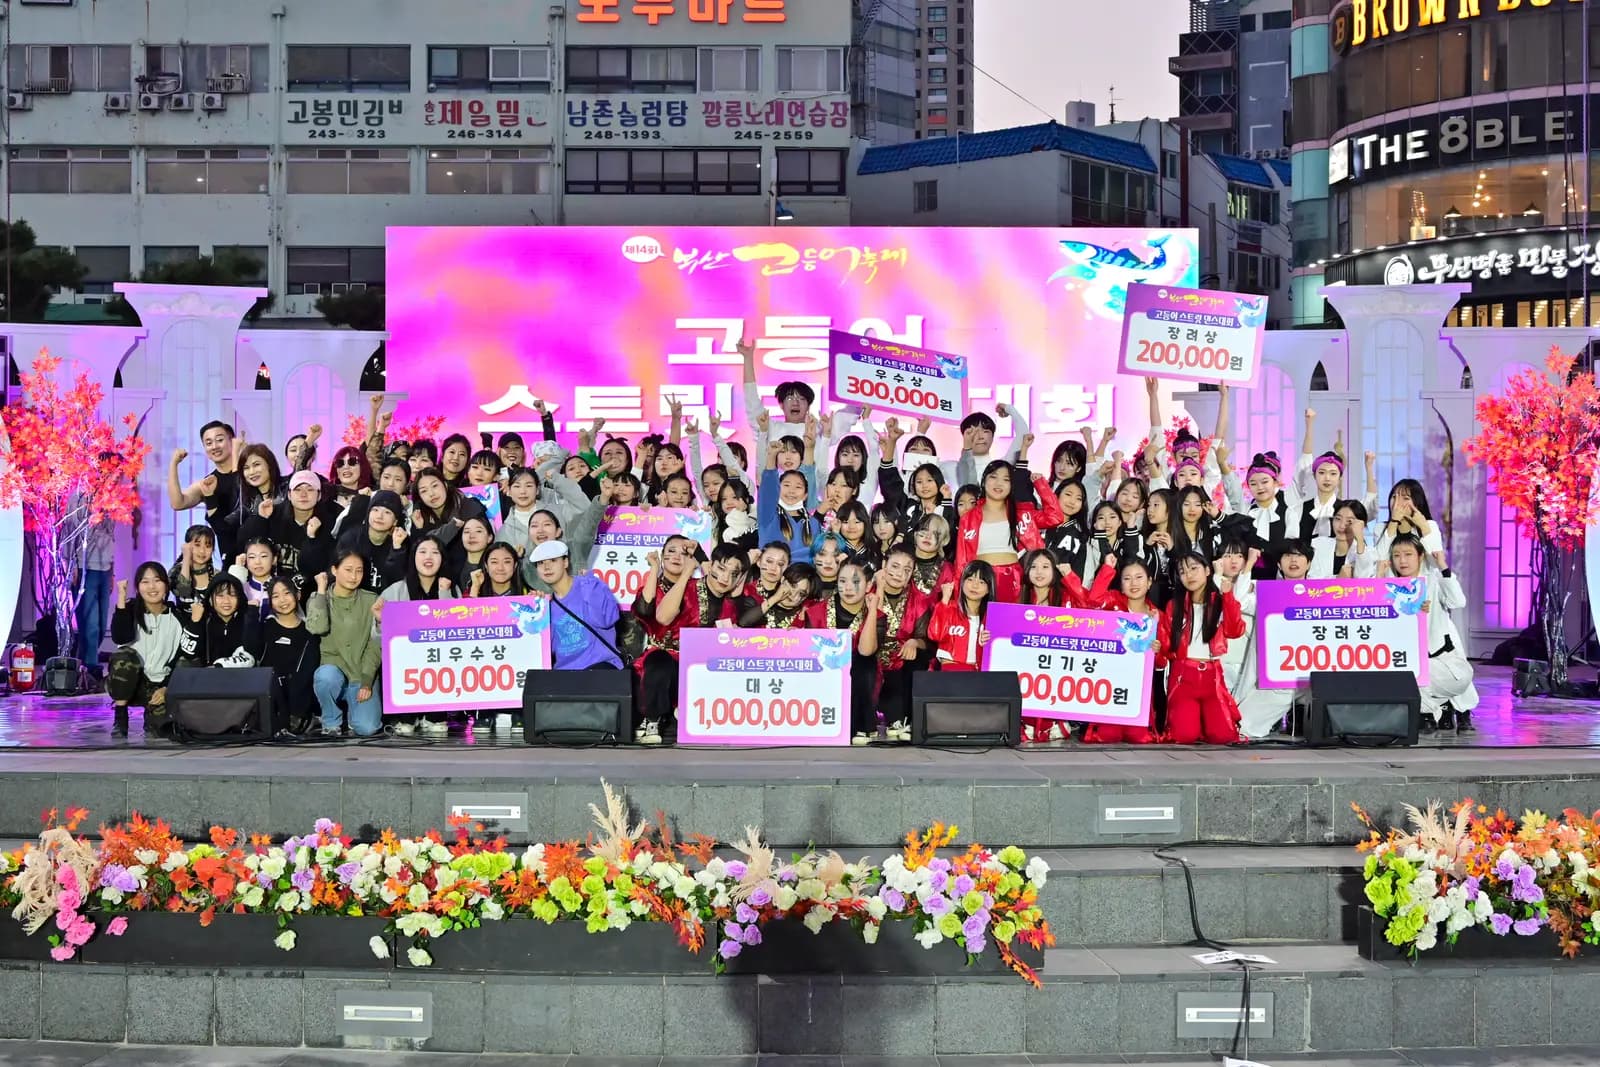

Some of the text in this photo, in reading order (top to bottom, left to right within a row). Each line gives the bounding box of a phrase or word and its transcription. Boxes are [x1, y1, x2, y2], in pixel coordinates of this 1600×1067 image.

[308, 129, 386, 139] 243-323
[447, 129, 523, 139] 246-3144
[584, 130, 661, 140] 248-1393
[734, 130, 814, 140] 245-2559
[1357, 129, 1430, 170] THE
[1155, 310, 1178, 321] 고등어
[1136, 339, 1243, 371] 200,000원
[847, 375, 953, 412] 300,000원
[606, 551, 652, 566] 우수
[1293, 608, 1321, 620] 고등어
[419, 629, 446, 641] 고등어
[1021, 635, 1049, 648] 고등어
[1280, 643, 1407, 672] 200,000원
[717, 658, 745, 671] 고등어
[1018, 672, 1129, 706] 00,000원
[693, 697, 836, 730] 1,000,000원
